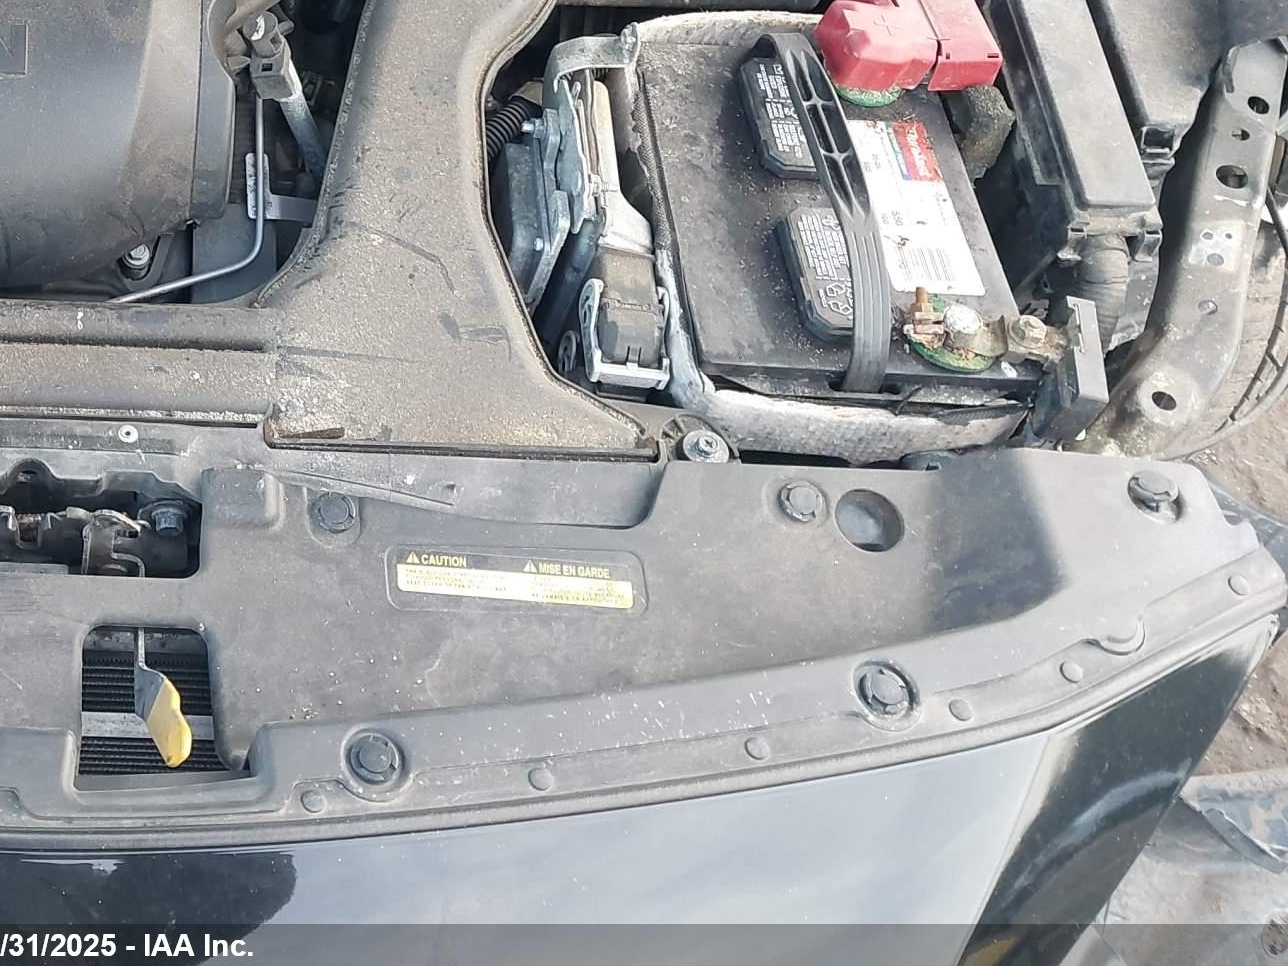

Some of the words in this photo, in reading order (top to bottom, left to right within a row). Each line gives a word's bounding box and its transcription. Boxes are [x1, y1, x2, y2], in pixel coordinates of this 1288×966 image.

[420, 554, 467, 568] CAUTION
[538, 562, 561, 575] MISE
[562, 565, 576, 576] EN
[577, 566, 611, 579] GARDE
